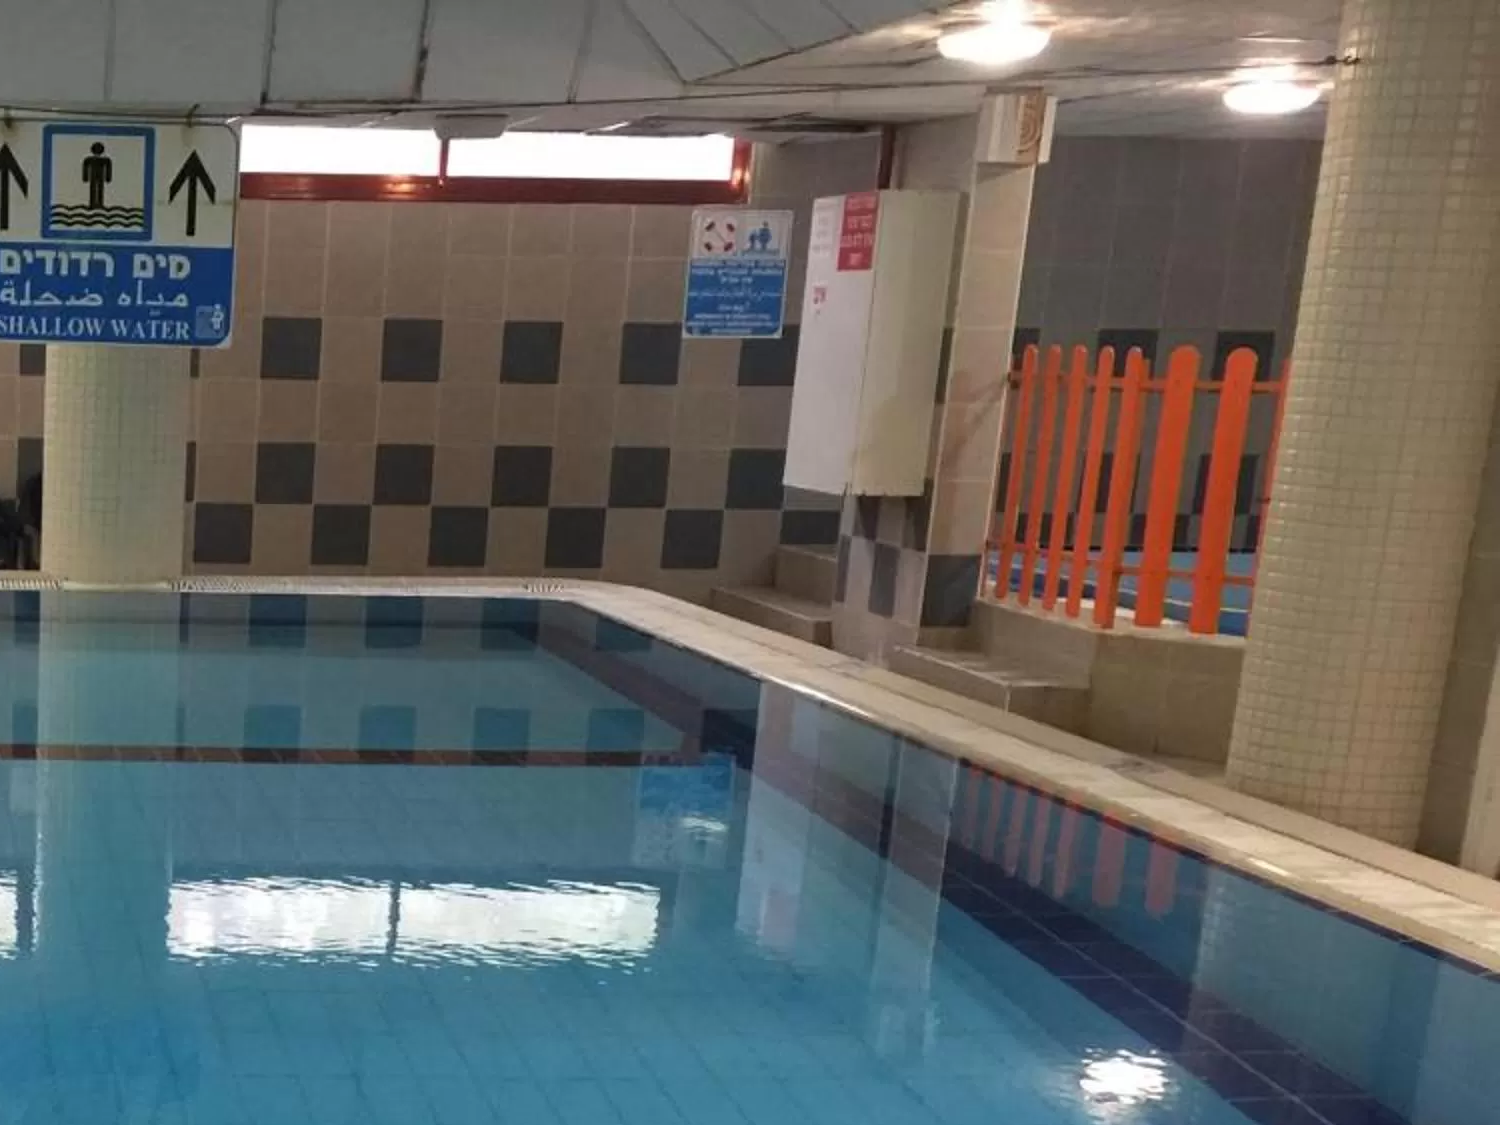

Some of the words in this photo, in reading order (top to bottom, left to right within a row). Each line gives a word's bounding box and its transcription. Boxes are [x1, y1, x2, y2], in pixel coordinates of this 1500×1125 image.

[0, 249, 115, 278] רדודים
[0, 279, 103, 307] ضحلة
[117, 279, 189, 316] مياه
[111, 318, 191, 340] WATER
